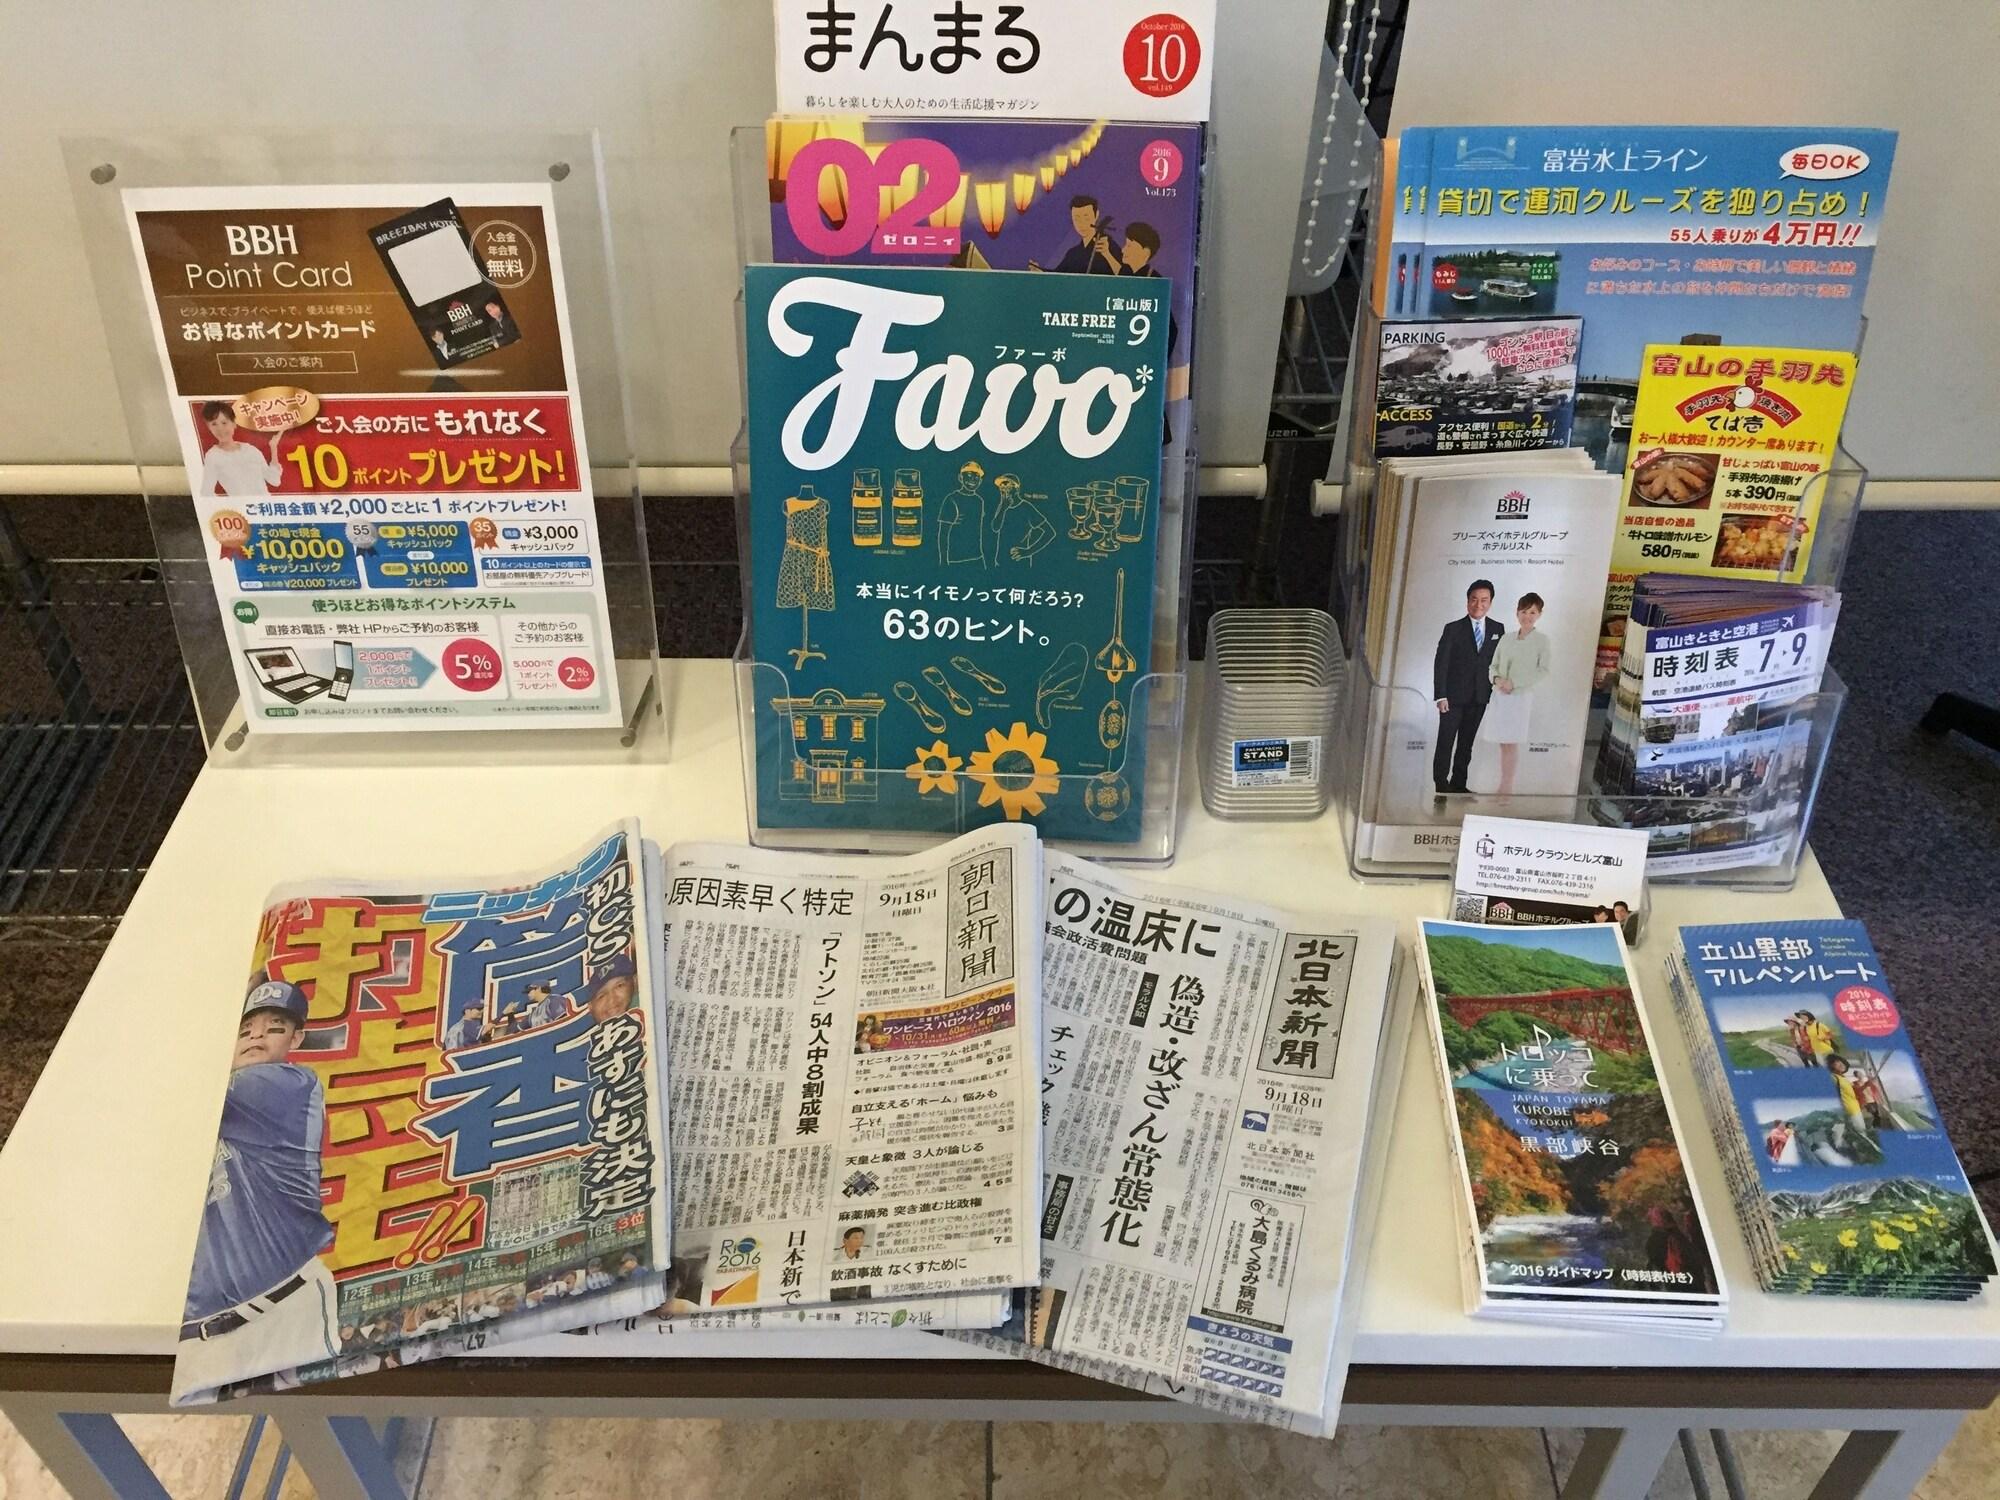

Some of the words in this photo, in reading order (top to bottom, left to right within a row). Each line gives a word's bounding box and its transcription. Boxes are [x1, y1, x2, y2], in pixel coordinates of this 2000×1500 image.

[804, 1, 1040, 74] まんまる
[1139, 34, 1187, 82] 10
[806, 95, 1040, 111] 暮らしを楽しむ大人のための生活応援マガジン
[1152, 147, 1171, 158] 2016
[1543, 147, 1707, 174] 富岩水上ライン
[1792, 153, 1861, 171] 毎日OK
[1153, 158, 1170, 182] 9
[786, 137, 961, 256] 02
[224, 224, 299, 256] BBH
[375, 221, 428, 246] BREEZBAY
[429, 218, 462, 230] HOTEL
[487, 231, 516, 243] 入会金
[488, 245, 518, 256] 年会費
[185, 262, 263, 290] Point
[272, 260, 353, 288] Card
[486, 259, 524, 278] 無料
[447, 304, 473, 322] BBH
[1106, 297, 1158, 312] 【富山版】
[1042, 312, 1079, 327] TAKE
[1081, 314, 1116, 329] FREE
[1127, 314, 1151, 346] 9
[182, 320, 377, 343] お得なポイントカード
[1384, 332, 1446, 345] PARKING
[252, 355, 324, 370] 入会のご案内
[994, 344, 1067, 362] ファーボ
[768, 276, 1146, 470] Favo
[1652, 353, 1847, 386] 富山の手羽先
[239, 391, 309, 416] キャンペーン
[315, 414, 430, 435] ご入会の方に
[435, 408, 547, 436] もれなく
[1380, 409, 1433, 422] ACCESS
[1706, 415, 1765, 433] てば壱
[1722, 457, 1821, 473] 甘じょっぱい富山の味
[1744, 485, 1786, 502] 390円
[1496, 498, 1530, 513] BBH
[215, 517, 243, 530] 100
[353, 525, 369, 535] 55
[407, 525, 458, 538] ¥5,000
[473, 521, 491, 532] 35
[523, 526, 578, 540] ¥3,000
[1452, 530, 1568, 541] ブリーズベイホテルグループ
[240, 539, 344, 562] ¥10,000
[510, 543, 575, 551] キャッシュバック
[1482, 541, 1533, 551] ホテルリスト
[257, 563, 341, 574] キャッシュバック
[411, 562, 468, 575] ¥10,000
[405, 578, 448, 587] プレゼント
[856, 582, 1085, 609] 本当にイイモノって何だろう?
[312, 598, 516, 613] 使うほどお得なポイントシステム
[517, 621, 577, 631] その他からの
[883, 608, 1050, 647] 63のヒント。
[515, 633, 584, 643] ご予約のお客様
[1655, 623, 1759, 650] 富山きときと空港
[455, 654, 492, 680] 5%
[1653, 646, 1740, 679] 時刻表
[564, 667, 588, 682] 2%
[1243, 750, 1283, 760] STAND
[1503, 845, 1533, 857] ホテル
[1535, 848, 1623, 867] クラウンヒルズ富山
[667, 877, 854, 917] 原因素早く特定
[879, 888, 937, 907] 9月18日
[957, 859, 999, 984] 朝日新聞
[1053, 885, 1222, 958] の温床に
[1490, 907, 1514, 920] BBH
[1698, 936, 1814, 963] 立山黒部
[1704, 962, 1878, 987] アルペンルート
[1273, 938, 1345, 1070] 北日本新聞
[1847, 990, 1872, 1000] 2016
[1840, 998, 1889, 1013] 時刻表
[883, 1023, 934, 1035] ワンピース
[937, 1012, 985, 1029] ハロウィン
[988, 1003, 1012, 1016] 2016
[1500, 1043, 1594, 1063] トロッコ
[1505, 1067, 1599, 1089] に乗って
[963, 1089, 998, 1102] 悩みも
[1264, 1086, 1323, 1109] 9月18日
[1512, 1094, 1548, 1104] JAPAN
[1556, 1096, 1606, 1105] TOYAMA
[577, 1011, 656, 1229] あすにも決定
[1100, 973, 1206, 1248] 偽造・改ざん常態化
[1513, 1105, 1571, 1117] KUROBE
[845, 1152, 906, 1167] 天皇と象徴
[912, 1142, 984, 1159] 3人が論じる
[1247, 1142, 1316, 1160] 北日本新聞社
[1520, 1136, 1620, 1156] 黒部峡谷
[894, 1197, 983, 1216] 突き進む比政権
[719, 1252, 761, 1267] 2016
[830, 1265, 883, 1281] 飲酒事故
[888, 1257, 968, 1276] なくすために
[1236, 1216, 1270, 1315] 大島くるみ病院
[1208, 1323, 1275, 1348] きょうの天気
